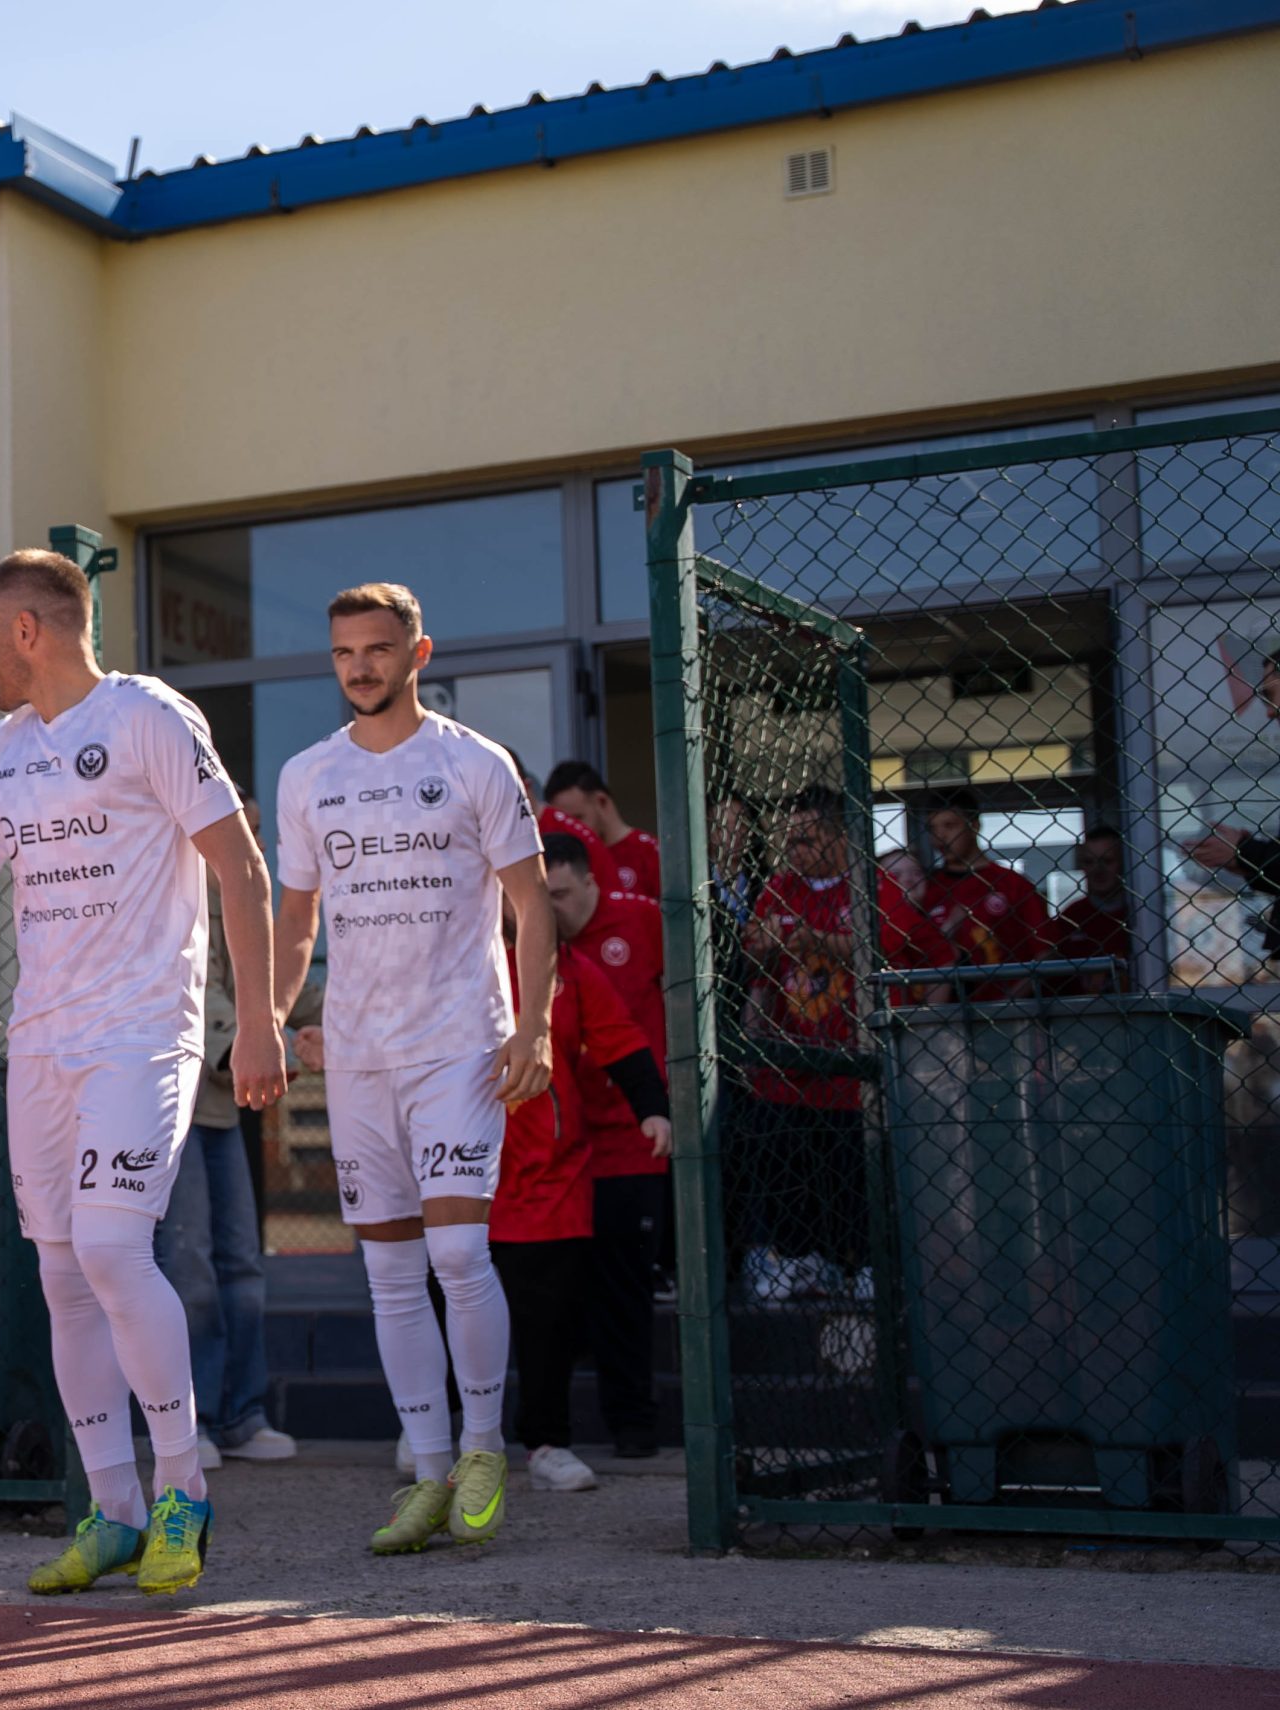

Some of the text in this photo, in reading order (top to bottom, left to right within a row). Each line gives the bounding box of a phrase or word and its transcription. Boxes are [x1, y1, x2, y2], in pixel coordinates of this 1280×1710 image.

[318, 795, 346, 809] JAKO
[350, 875, 453, 895] architekten
[81, 901, 118, 918] CITY
[347, 909, 453, 929] MONOPOL CITY
[80, 1148, 99, 1190] 2
[452, 1165, 484, 1178] JAKO
[111, 1176, 146, 1193] JAKO
[396, 1403, 431, 1414] AKO
